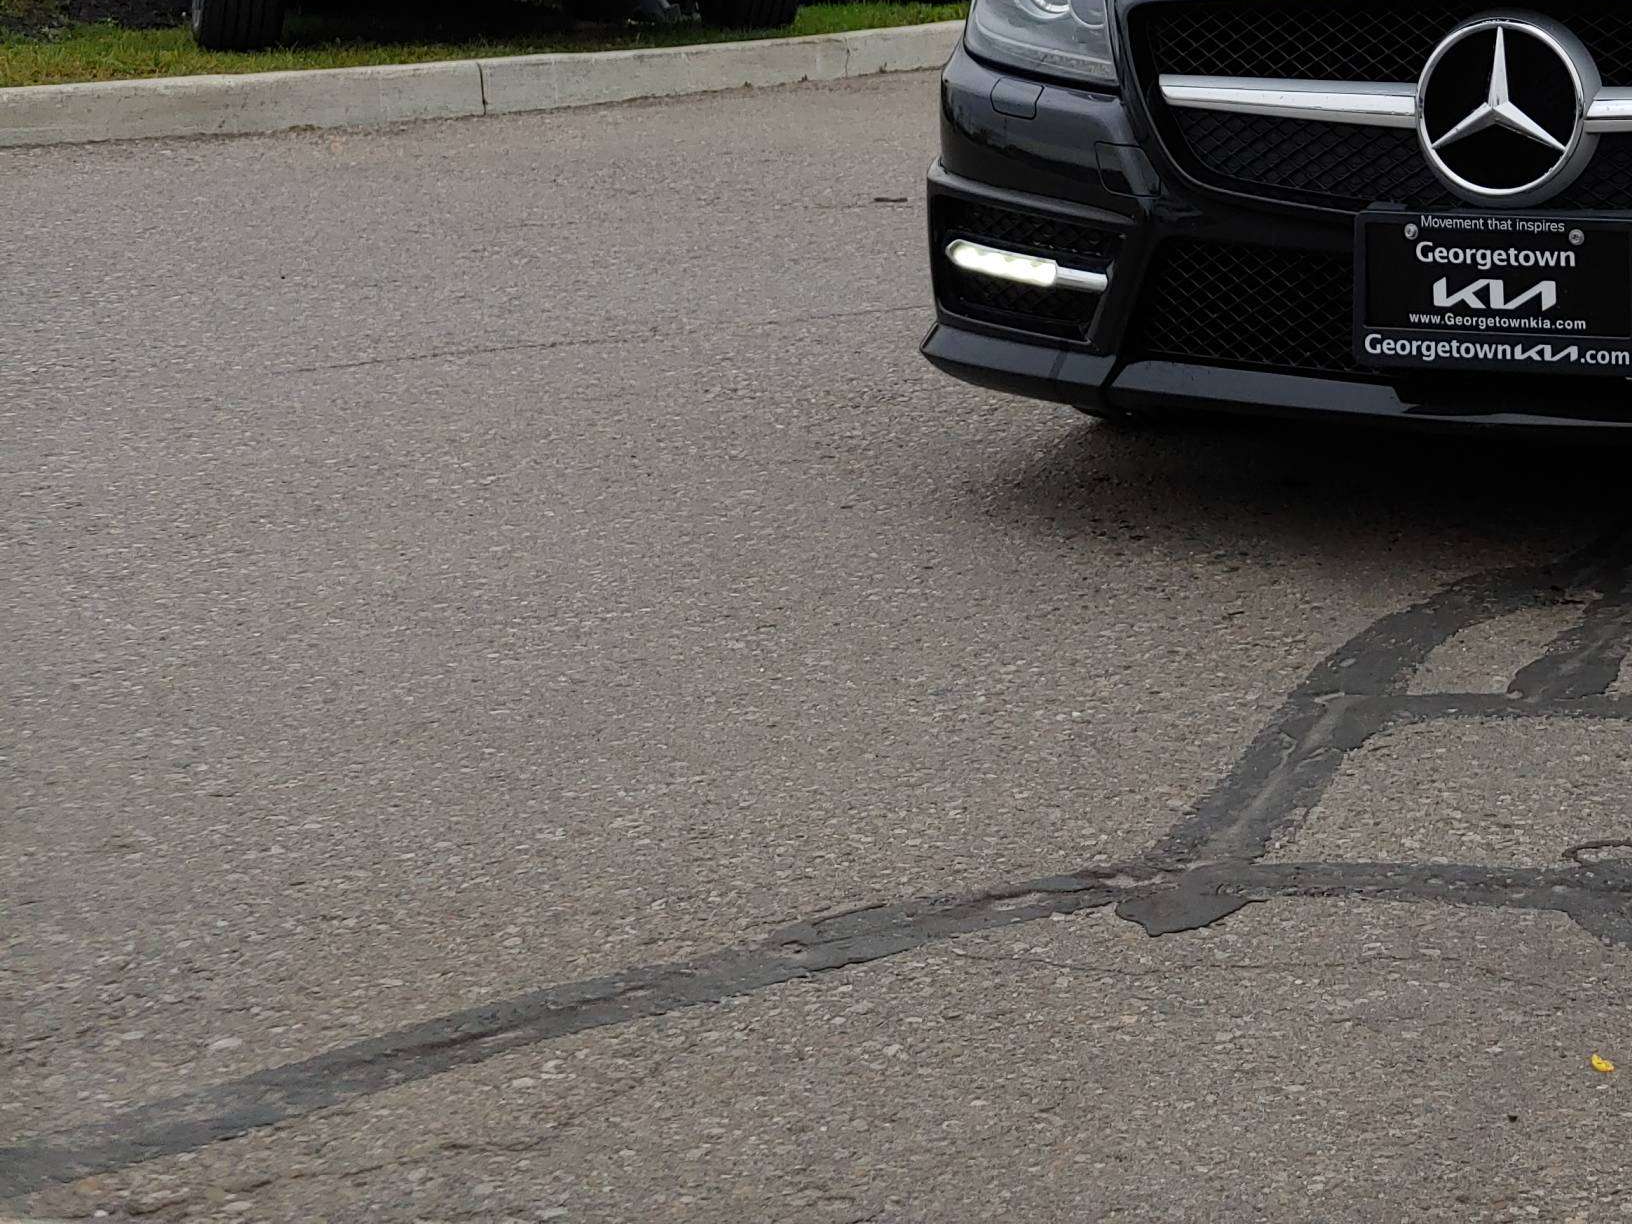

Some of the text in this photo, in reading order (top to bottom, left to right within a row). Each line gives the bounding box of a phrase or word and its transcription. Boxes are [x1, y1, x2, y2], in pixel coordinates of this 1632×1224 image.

[1420, 215, 1565, 234] Movement that inspires
[1415, 241, 1576, 270] Georgetown
[1433, 276, 1556, 312] KIA
[1409, 313, 1586, 330] www.Georgetownkia.com
